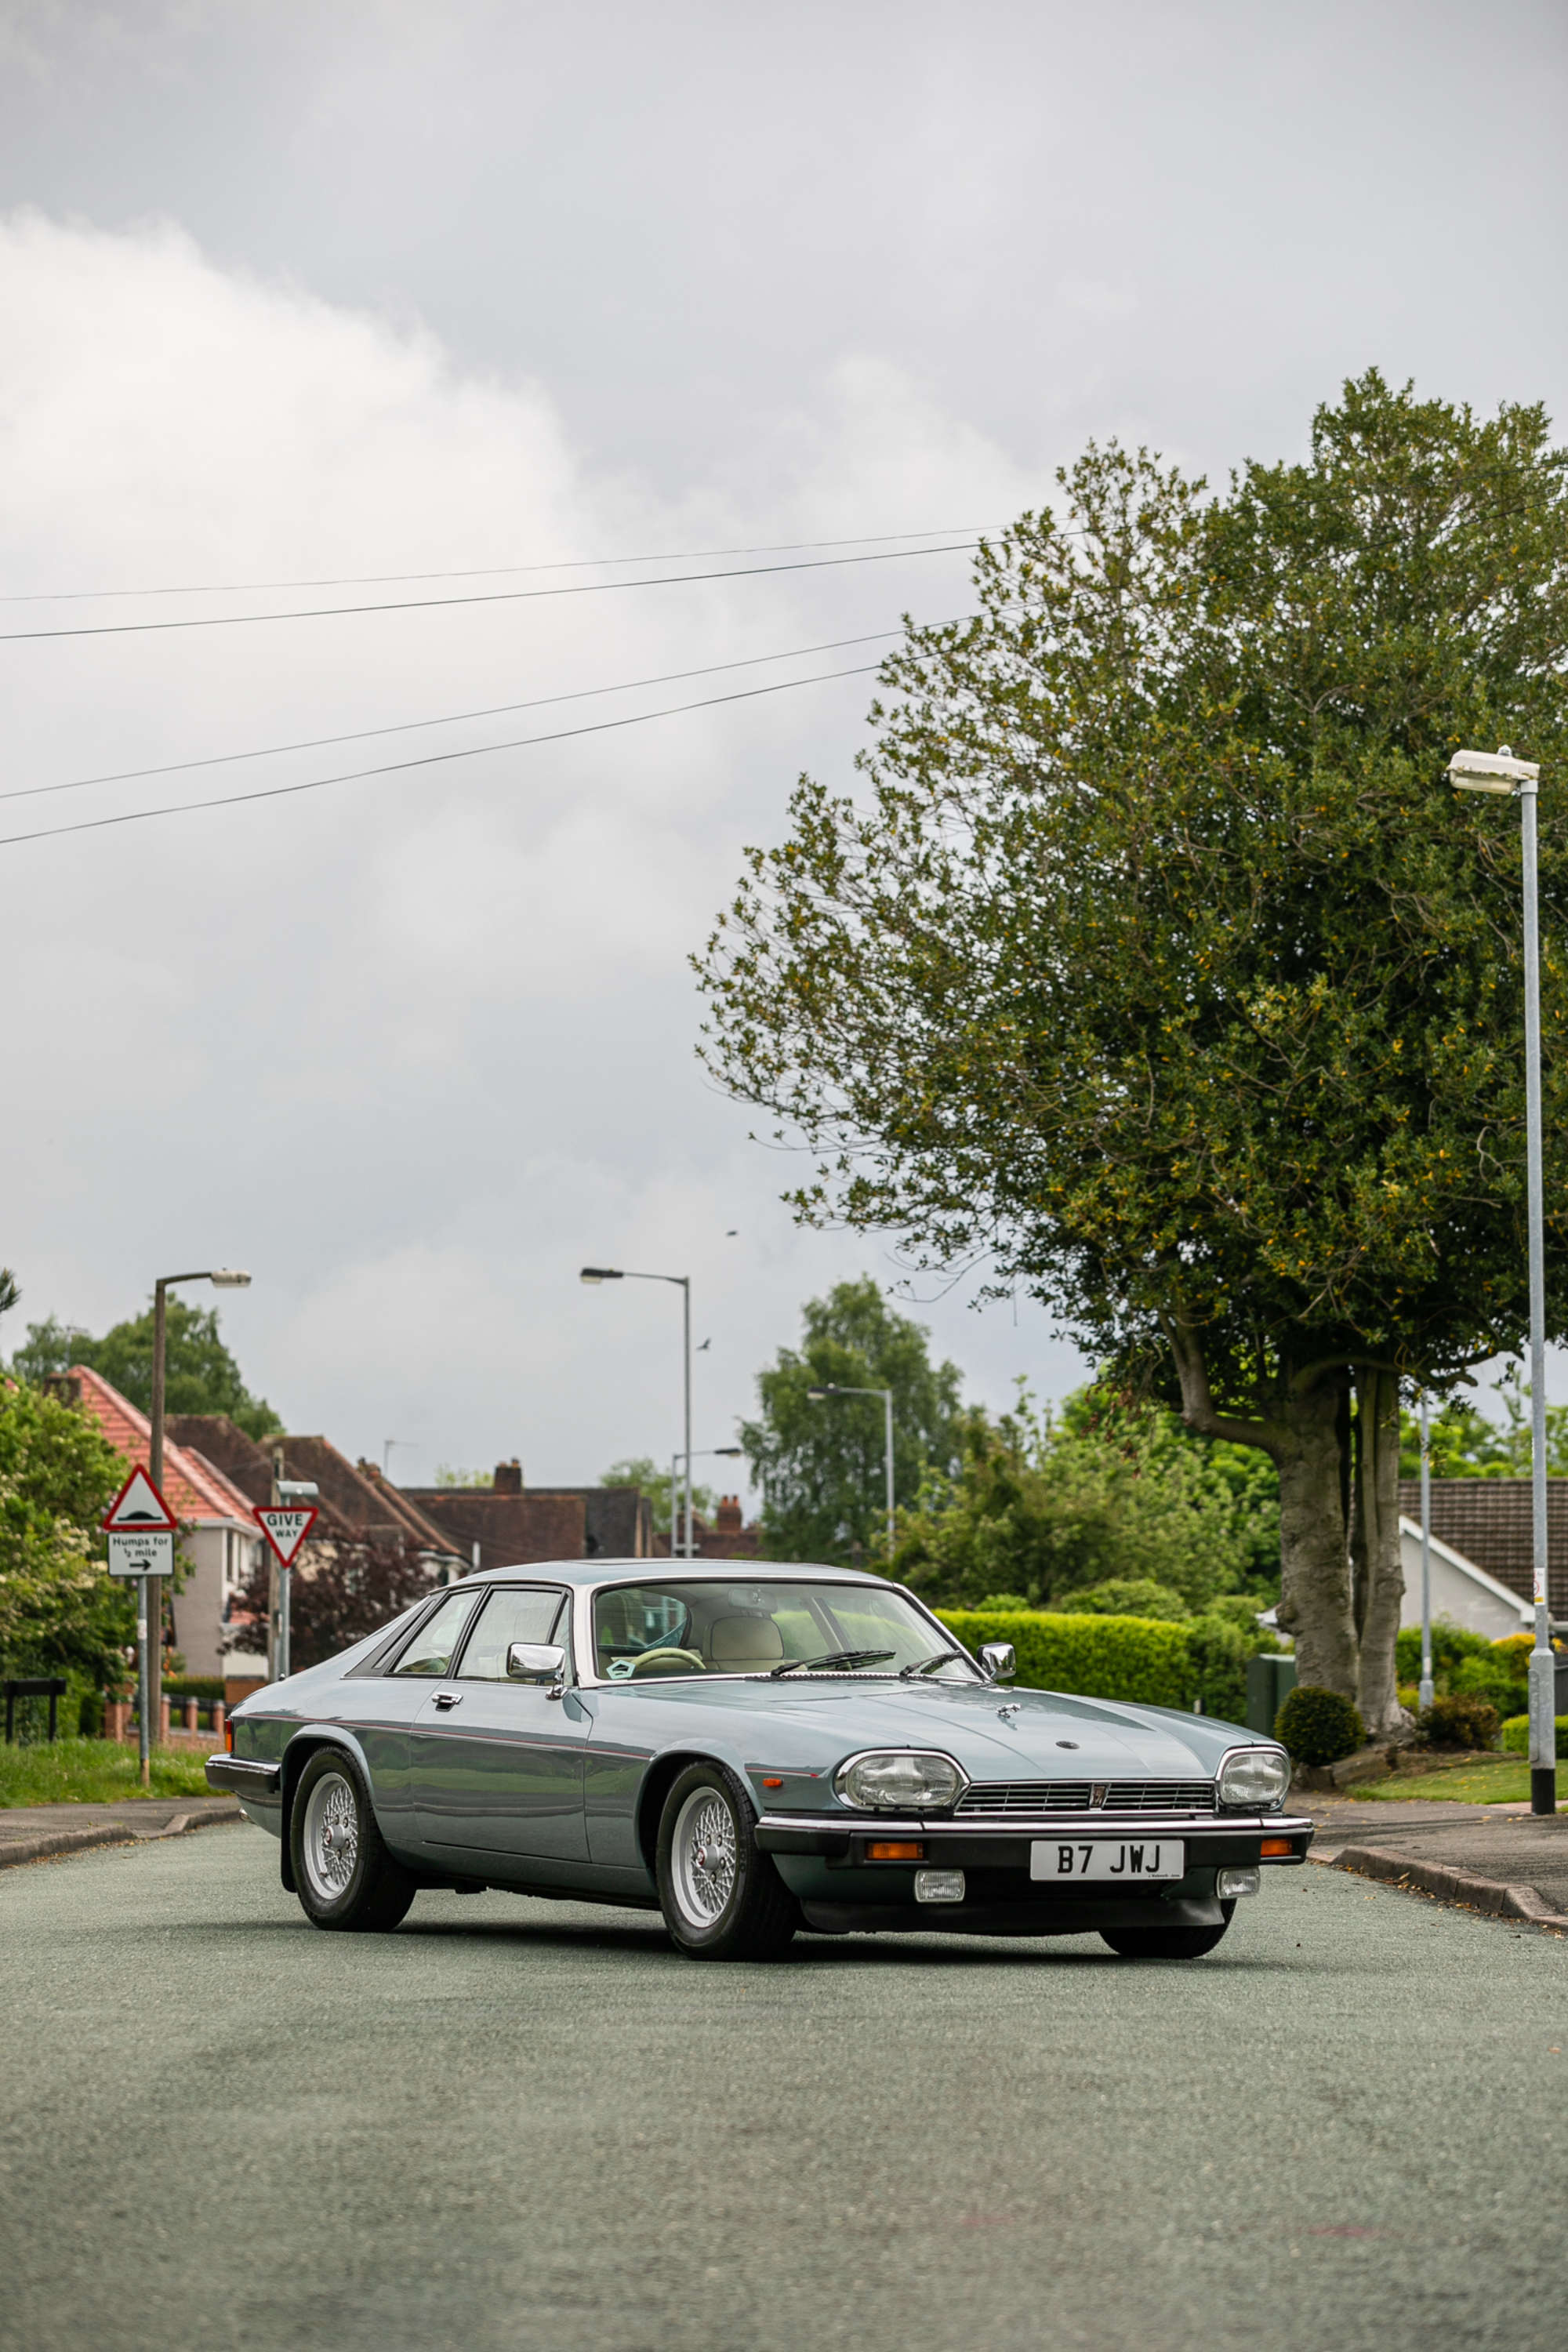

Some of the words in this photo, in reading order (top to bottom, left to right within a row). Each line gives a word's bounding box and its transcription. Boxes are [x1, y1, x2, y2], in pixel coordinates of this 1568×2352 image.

[267, 1513, 303, 1526] GIVE
[275, 1529, 298, 1537] WAY
[113, 1537, 150, 1547] Humps
[154, 1536, 168, 1545] for
[1058, 1845, 1093, 1873] B7
[1110, 1845, 1160, 1873] JWJ
